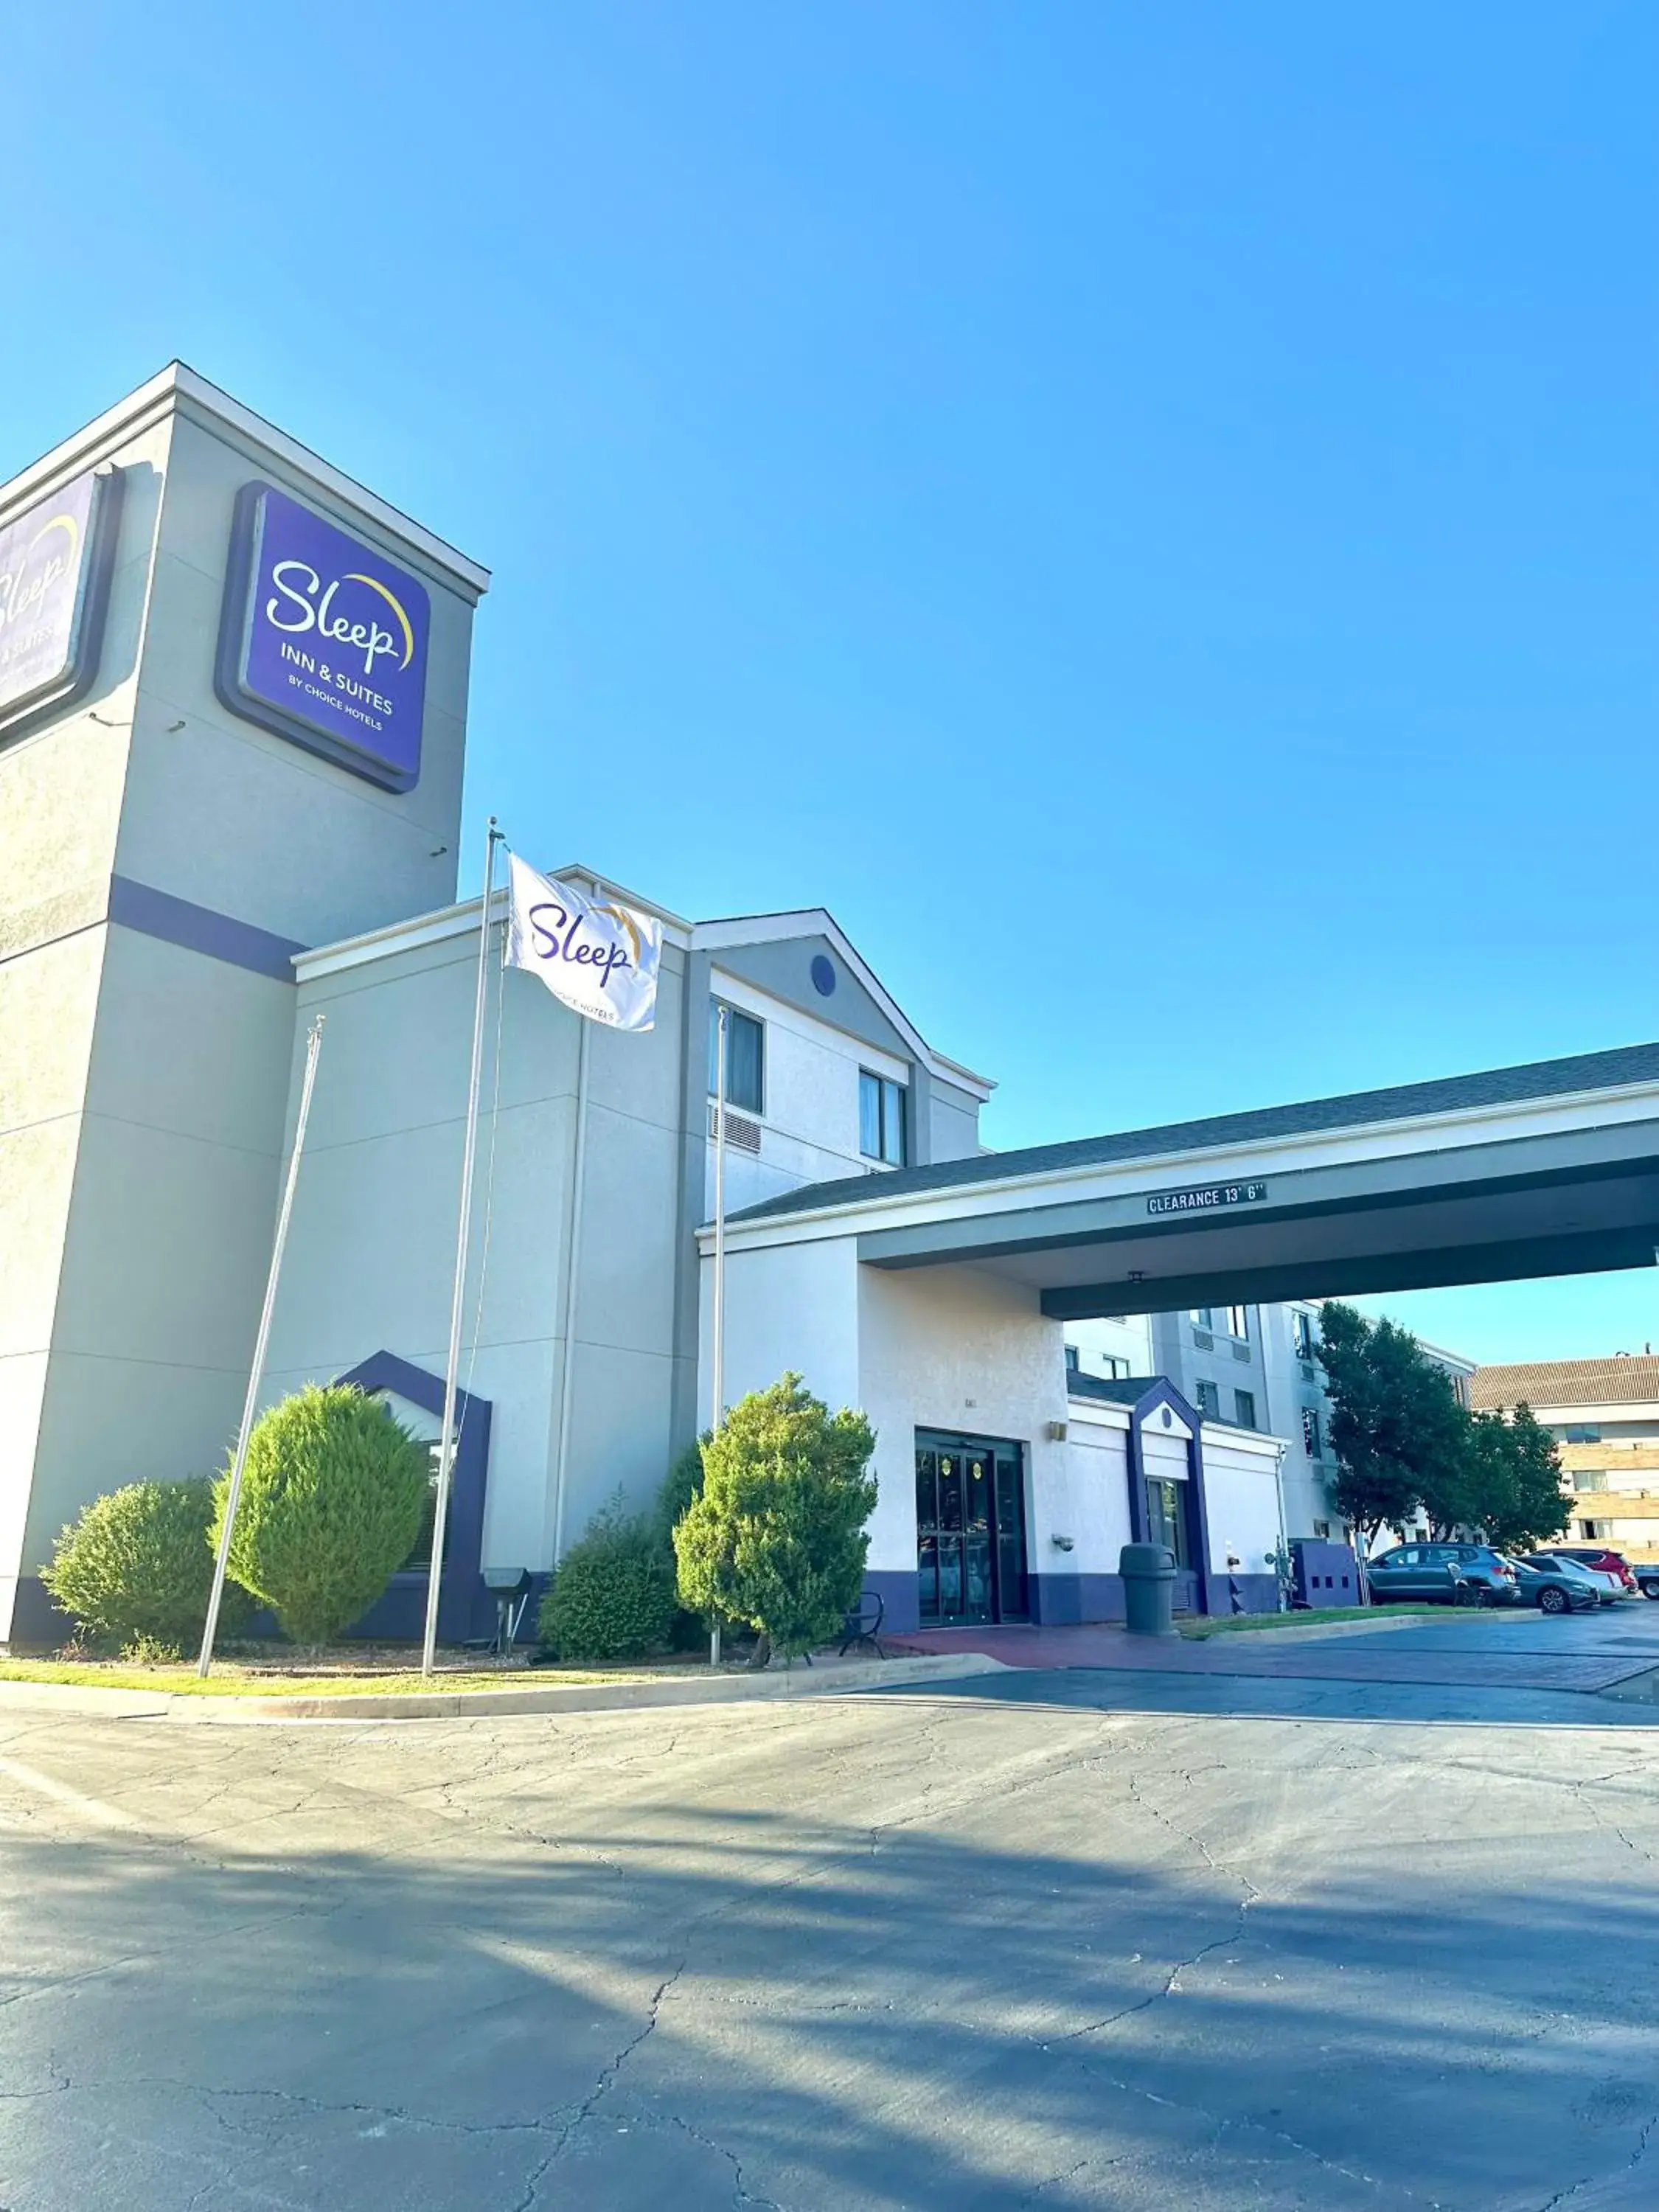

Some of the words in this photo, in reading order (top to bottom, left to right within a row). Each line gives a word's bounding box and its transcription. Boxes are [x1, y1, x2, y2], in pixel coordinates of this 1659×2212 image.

[266, 560, 399, 674] Sleep
[280, 642, 315, 673] INN
[319, 664, 332, 683] &
[335, 673, 393, 715] SUITES
[288, 675, 303, 688] BY
[305, 684, 343, 710] CHOICE
[344, 705, 383, 731] HOTELS
[529, 903, 632, 988] Sleep
[1150, 1190, 1220, 1213] CLEARANCE
